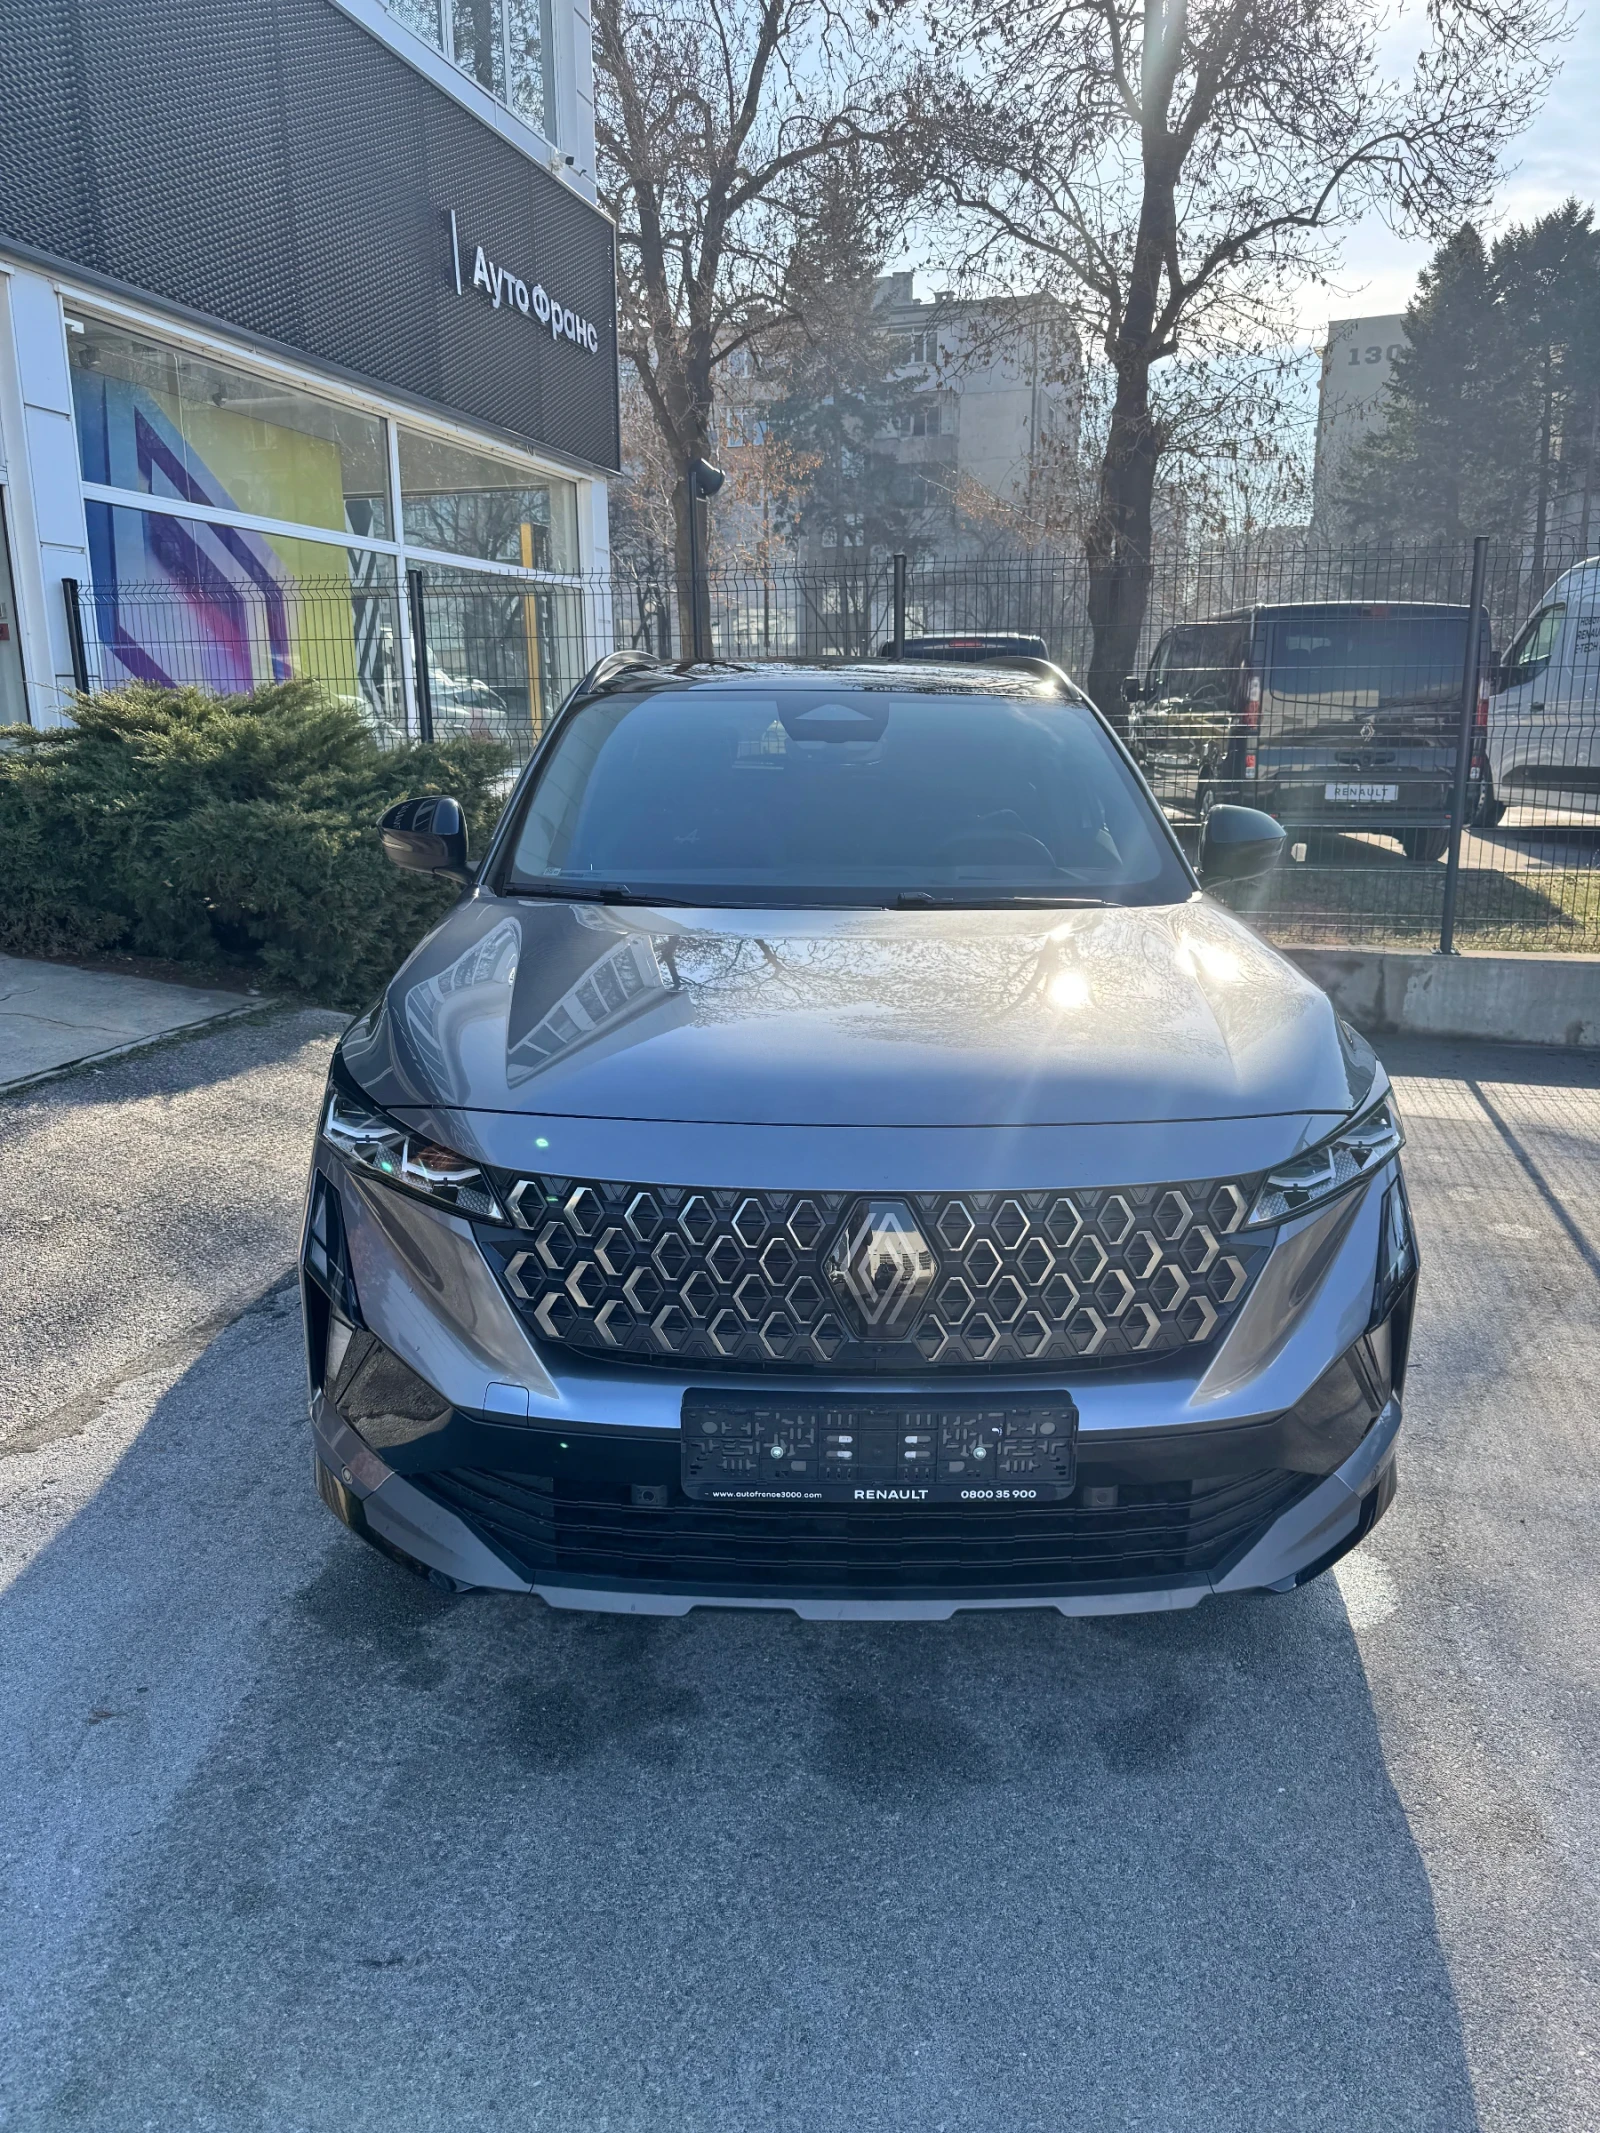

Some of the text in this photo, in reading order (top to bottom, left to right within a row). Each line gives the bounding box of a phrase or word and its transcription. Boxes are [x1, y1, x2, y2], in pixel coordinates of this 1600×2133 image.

[473, 245, 598, 353] Ауто Франс
[1335, 788, 1389, 797] RENAULT
[854, 1489, 929, 1500] RENAULT
[960, 1489, 994, 1499] 0800
[995, 1489, 1011, 1499] 35
[1012, 1489, 1037, 1499] 900
